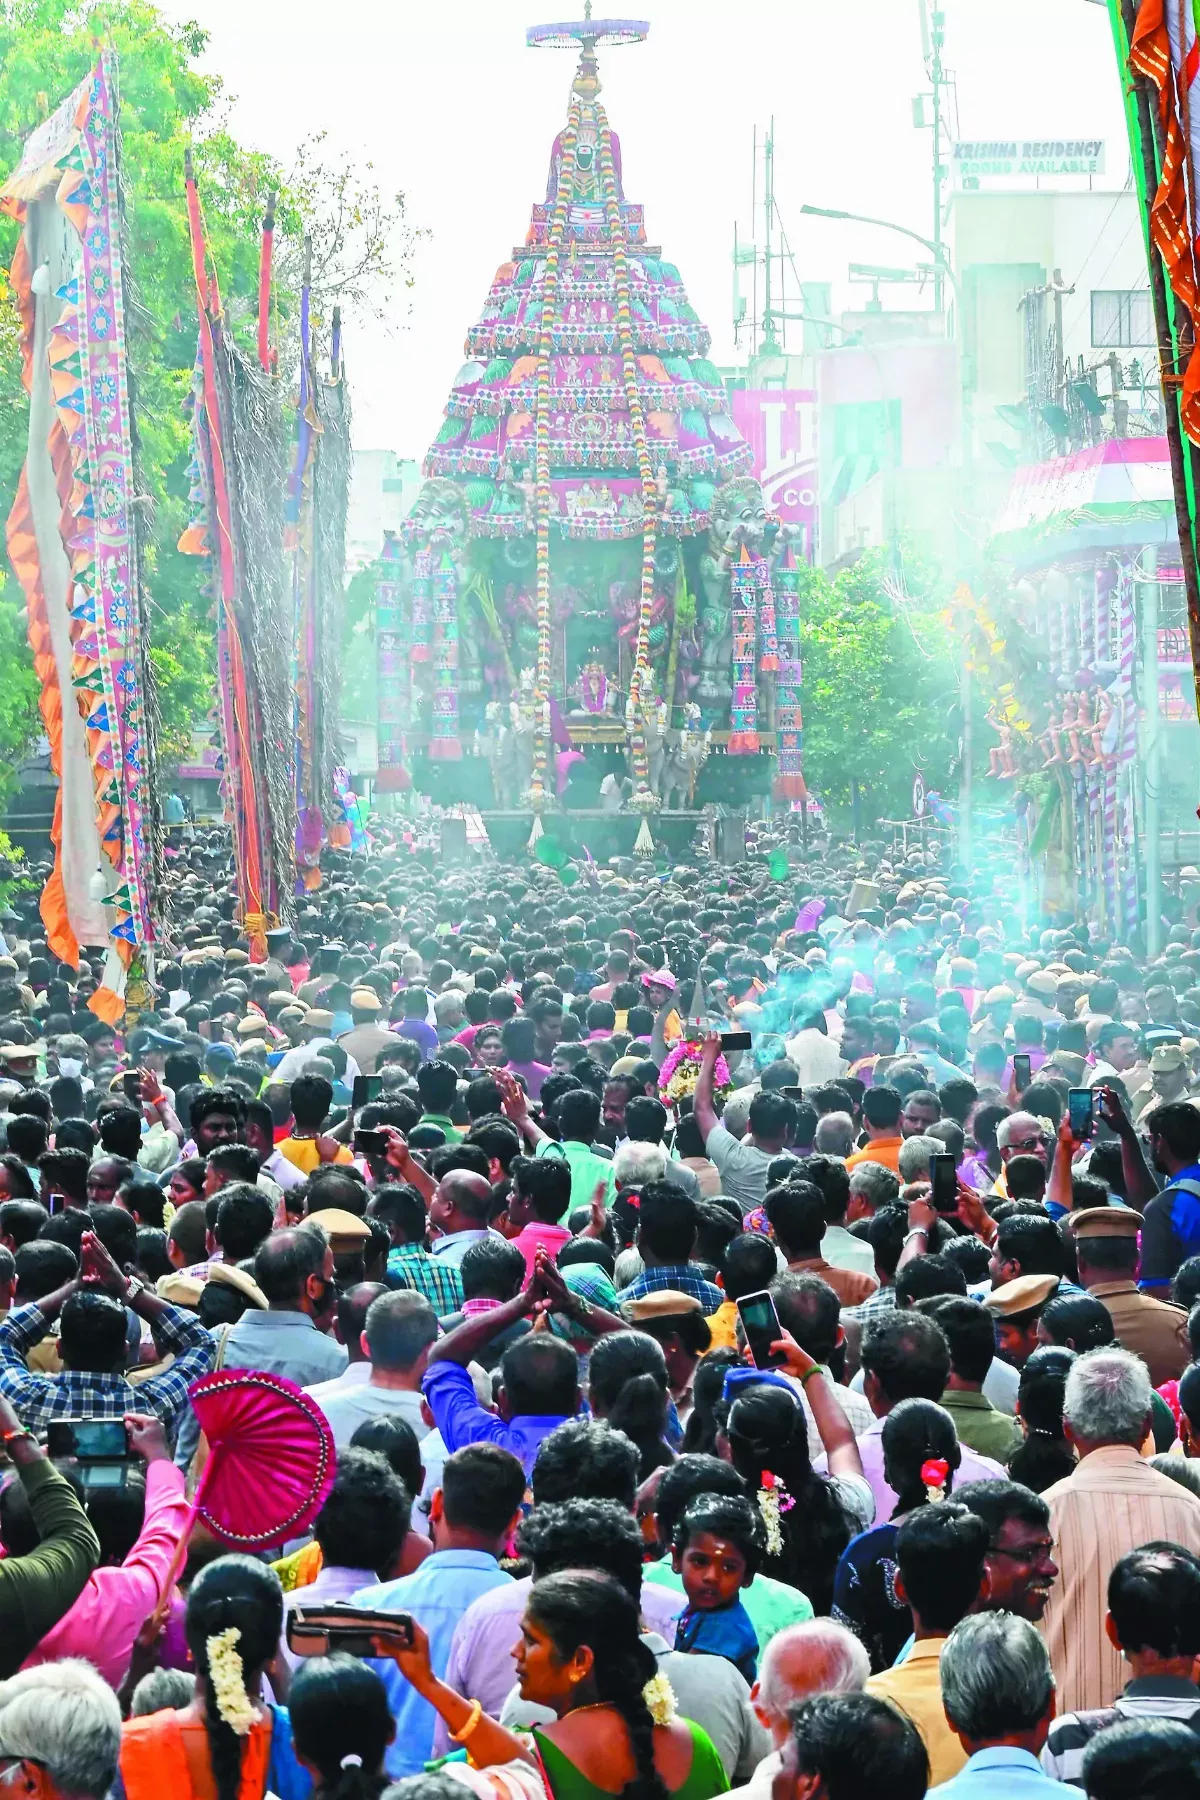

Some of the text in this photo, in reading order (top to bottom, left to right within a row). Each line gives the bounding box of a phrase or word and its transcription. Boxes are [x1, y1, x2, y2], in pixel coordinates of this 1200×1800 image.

[954, 141, 1102, 159] KRISHNA RESIDENCY
[1018, 160, 1097, 173] AVAILABLE
[783, 489, 819, 506] CO
